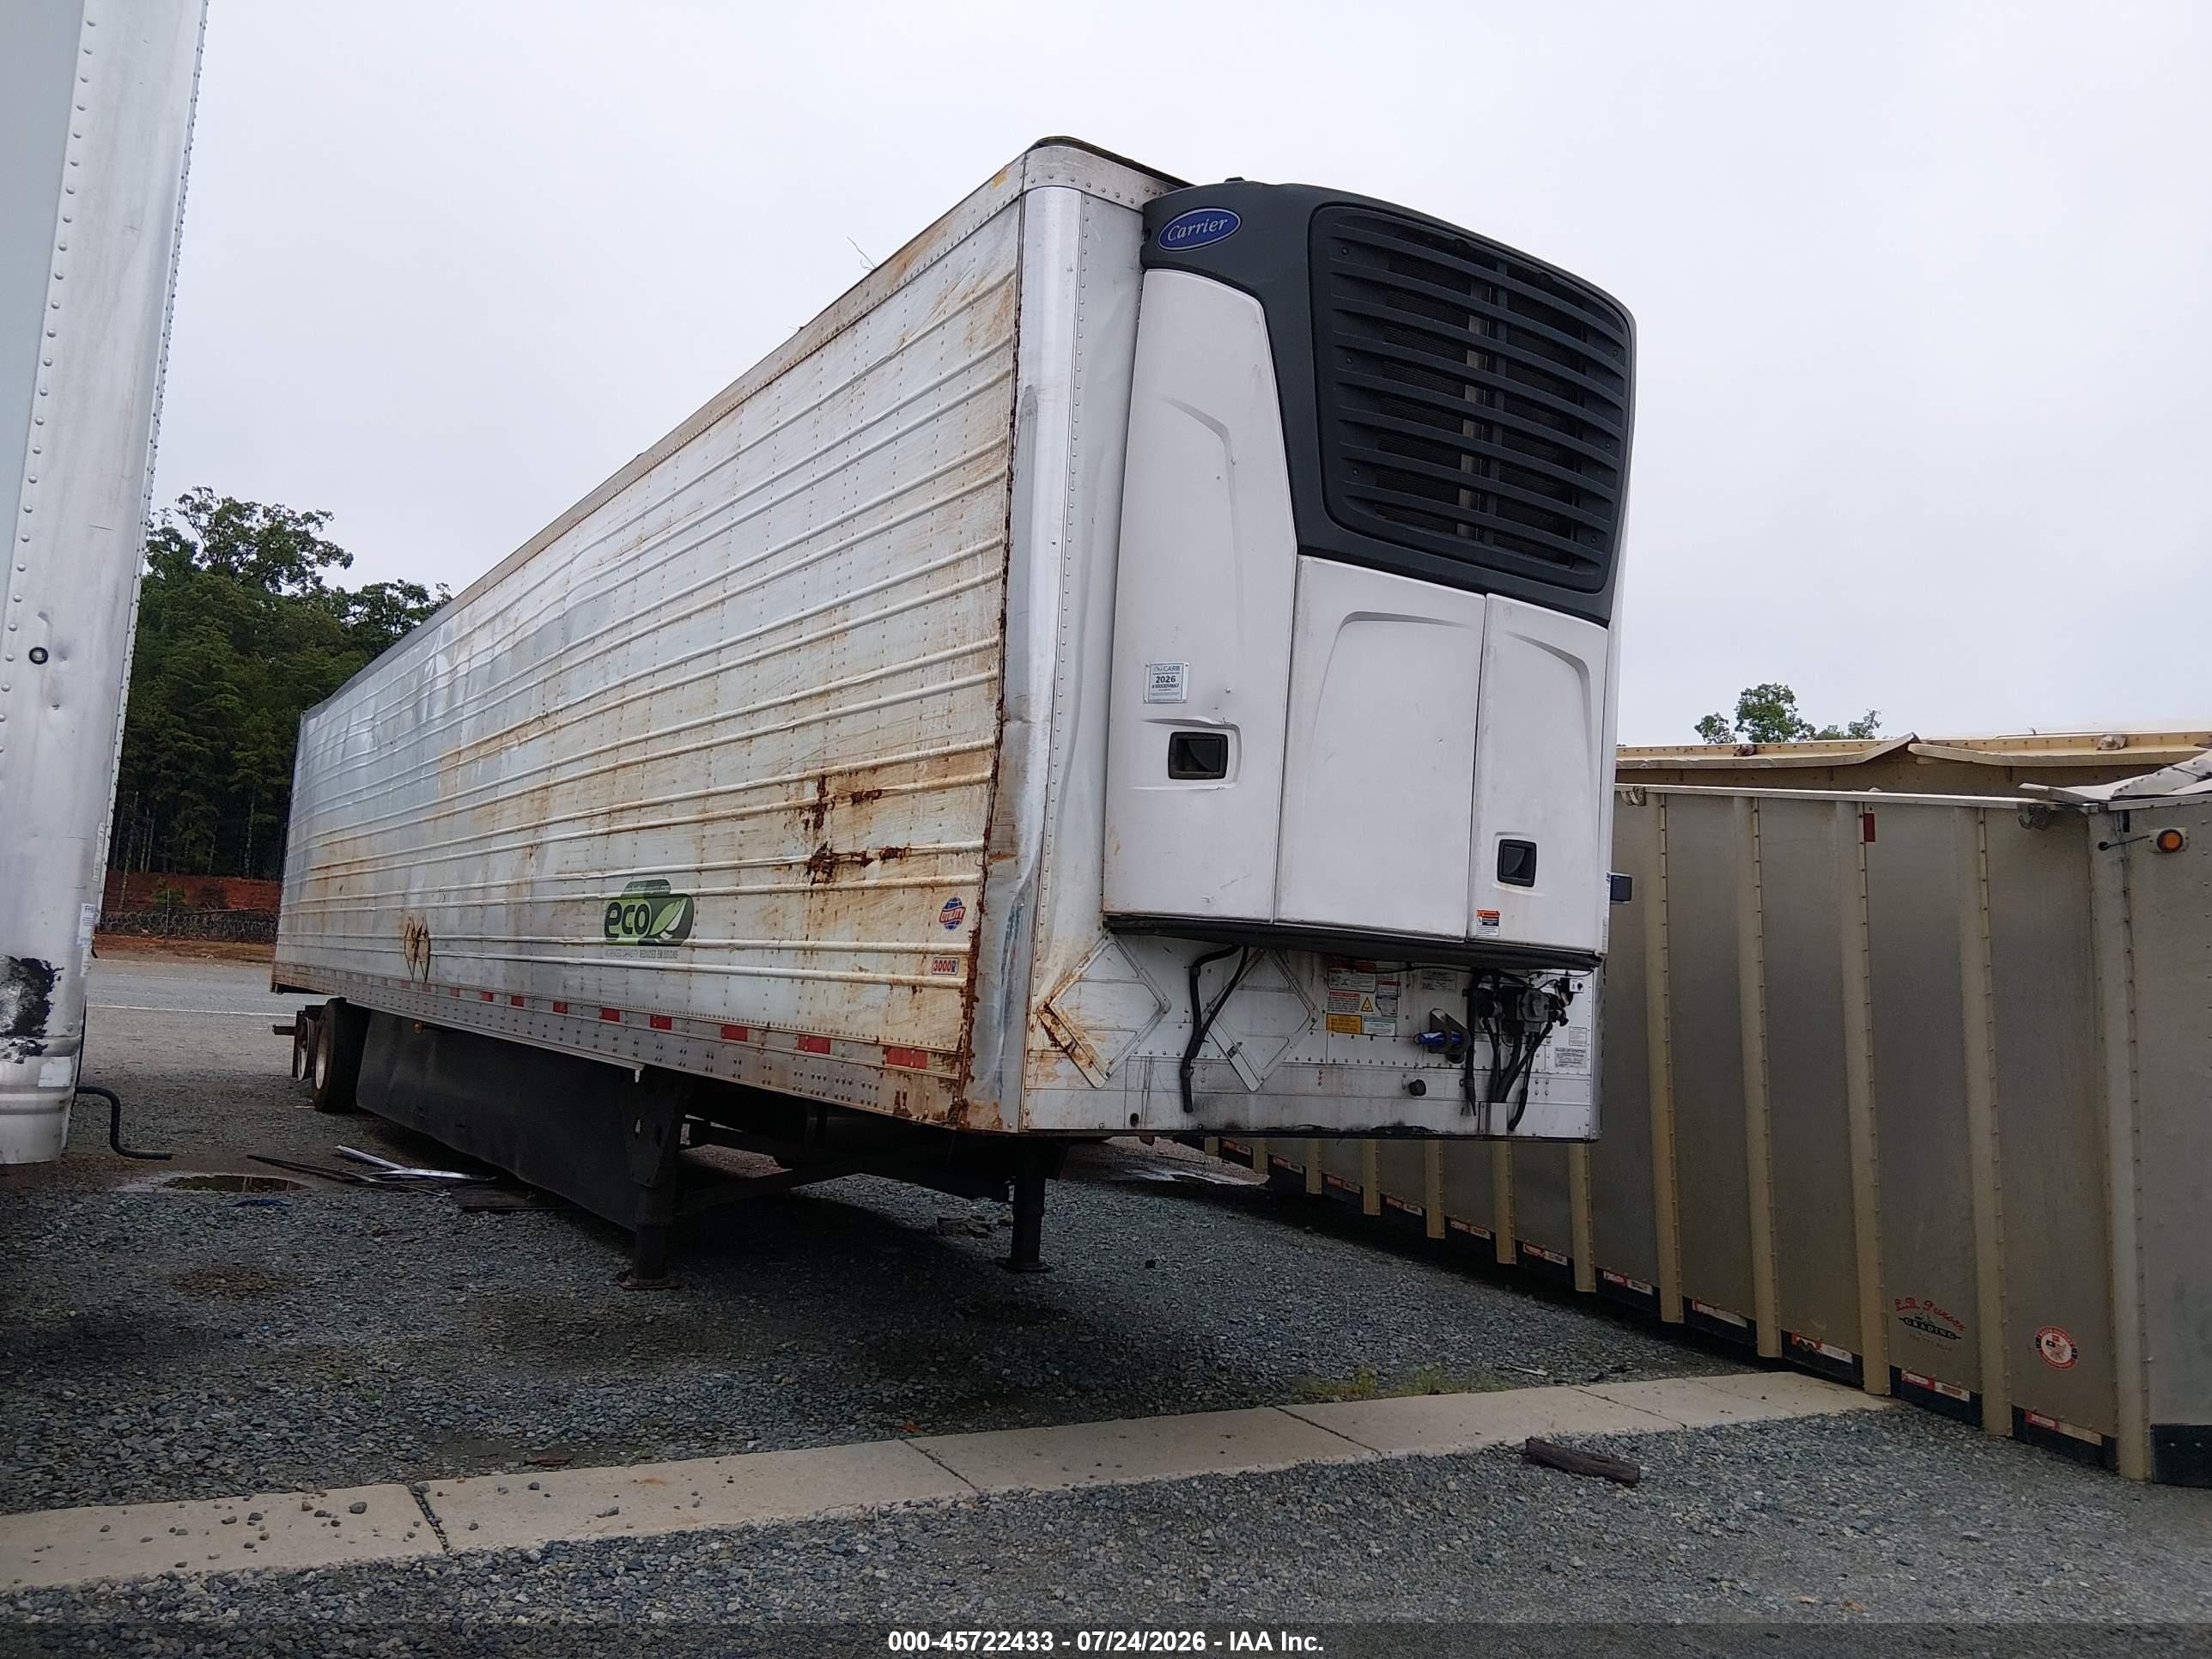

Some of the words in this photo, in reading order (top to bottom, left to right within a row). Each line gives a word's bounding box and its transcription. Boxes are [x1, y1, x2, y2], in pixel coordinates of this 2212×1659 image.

[1167, 217, 1229, 241] Carrier
[1155, 675, 1176, 684] 2026
[604, 901, 651, 940] eco
[940, 907, 965, 922] UTILITY
[933, 959, 957, 973] 3000R
[1904, 1318, 1956, 1339] GRADING
